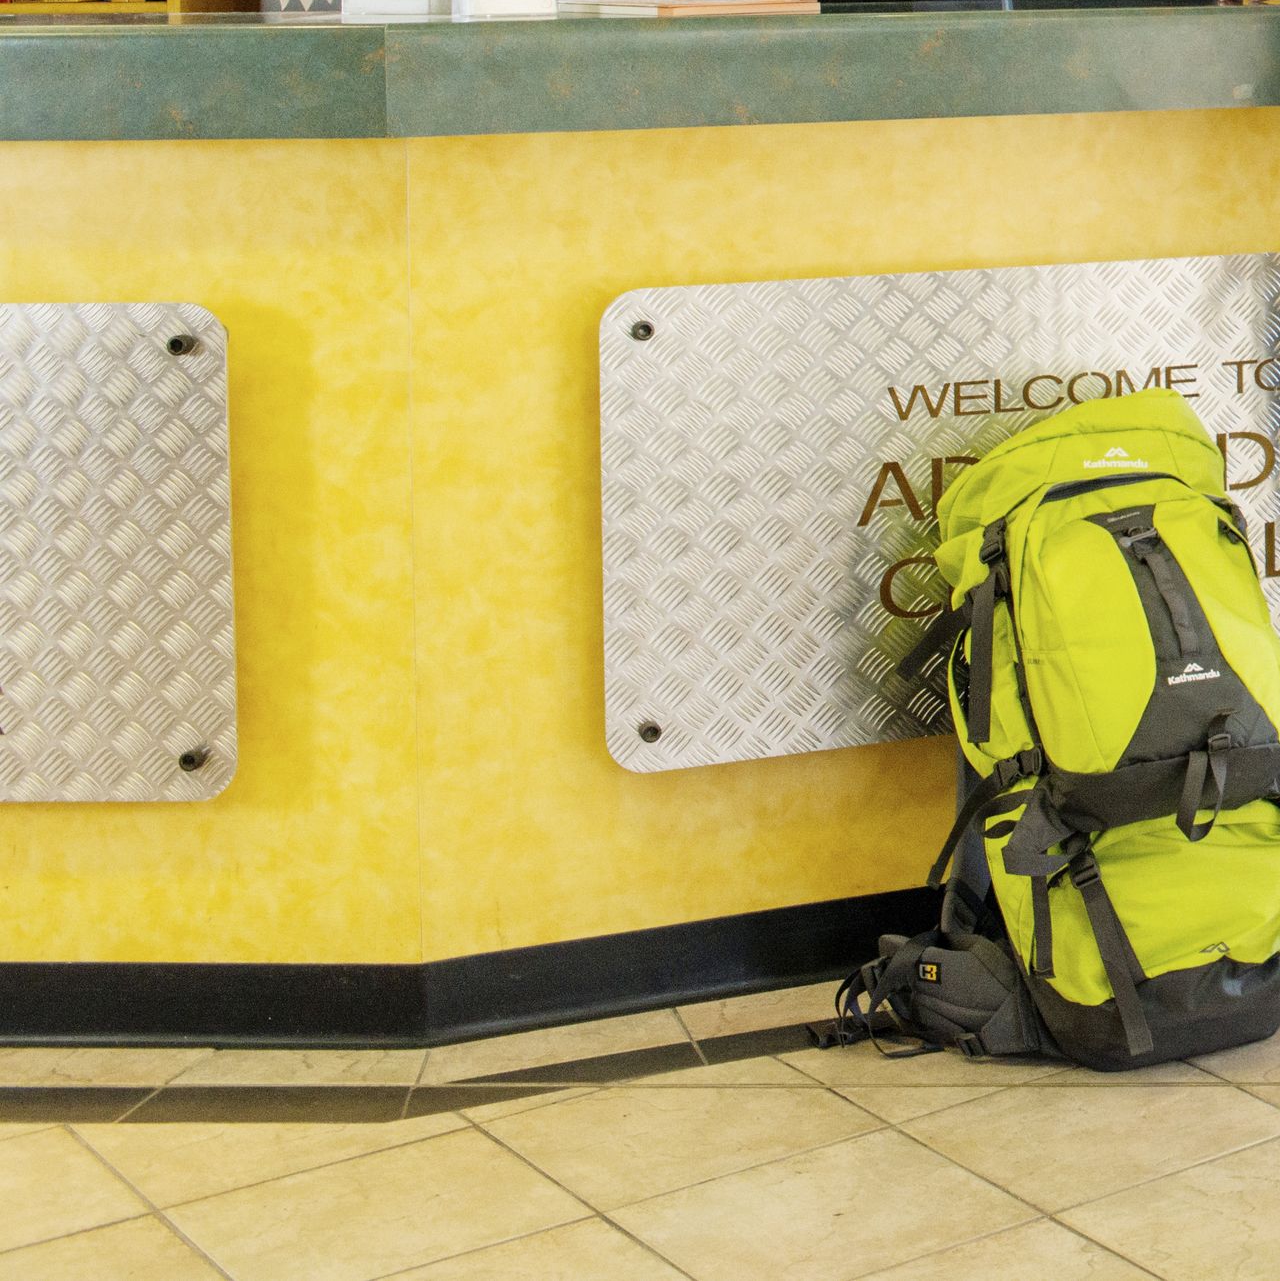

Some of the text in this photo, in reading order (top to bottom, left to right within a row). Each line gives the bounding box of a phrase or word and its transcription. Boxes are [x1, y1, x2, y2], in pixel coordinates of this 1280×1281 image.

[887, 363, 1200, 422] WELCOME
[1083, 457, 1150, 469] Kathmandu
[1167, 668, 1221, 686] Kathmandu
